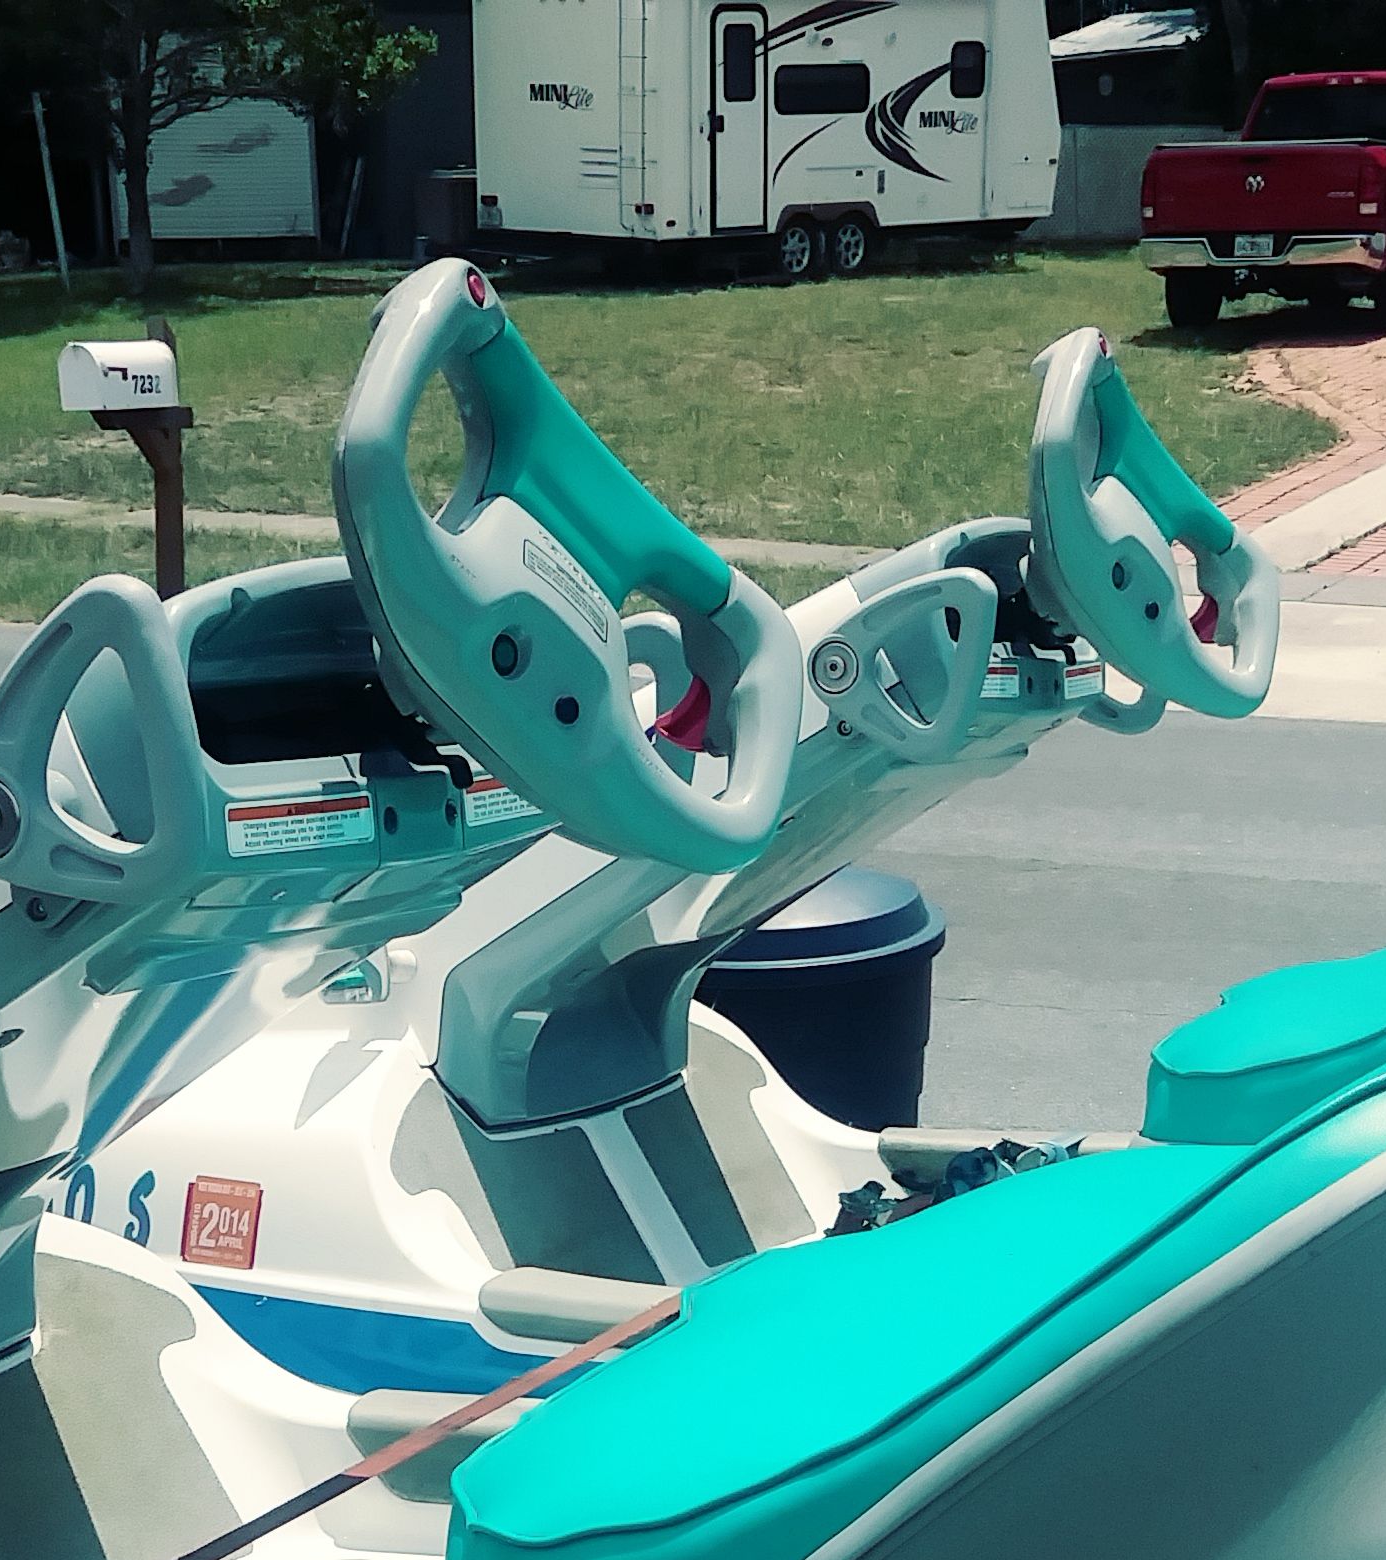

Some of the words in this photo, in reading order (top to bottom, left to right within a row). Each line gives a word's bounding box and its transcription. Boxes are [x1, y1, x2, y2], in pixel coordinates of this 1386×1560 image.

[530, 83, 568, 101] MINI
[919, 111, 955, 128] MINI
[131, 374, 162, 394] 7232
[198, 1203, 251, 1248] 2014
[217, 1235, 244, 1250] APRIL
